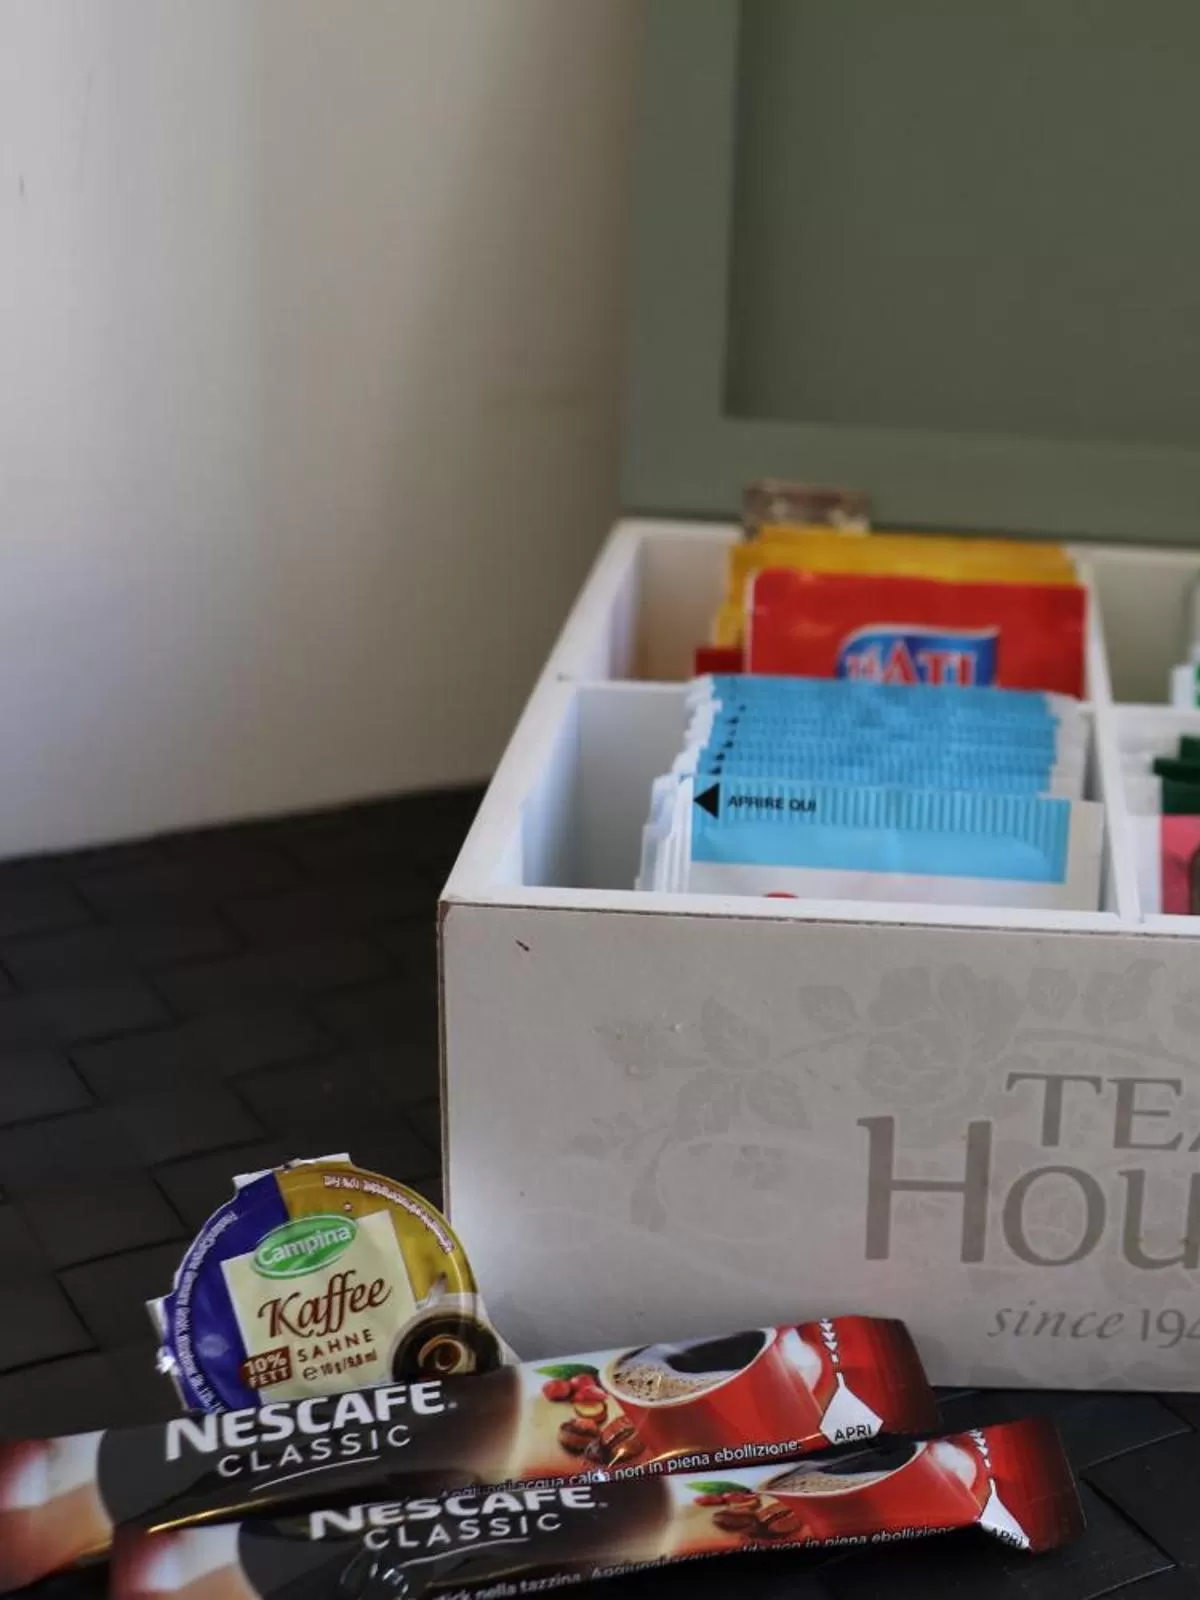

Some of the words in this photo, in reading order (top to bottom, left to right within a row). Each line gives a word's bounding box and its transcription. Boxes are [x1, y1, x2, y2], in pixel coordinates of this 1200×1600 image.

[258, 1225, 352, 1266] Campina
[258, 1269, 393, 1338] Kaffee
[987, 1300, 1125, 1338] since
[244, 1352, 287, 1374] 10%
[297, 1329, 373, 1363] SAHNE
[249, 1367, 289, 1388] FETT
[834, 1424, 873, 1442] APRI
[217, 1425, 411, 1477] CLASSIC
[615, 1465, 645, 1482] non
[649, 1460, 663, 1474] in
[668, 1453, 710, 1475] piena
[363, 1513, 561, 1550] CLASSIC
